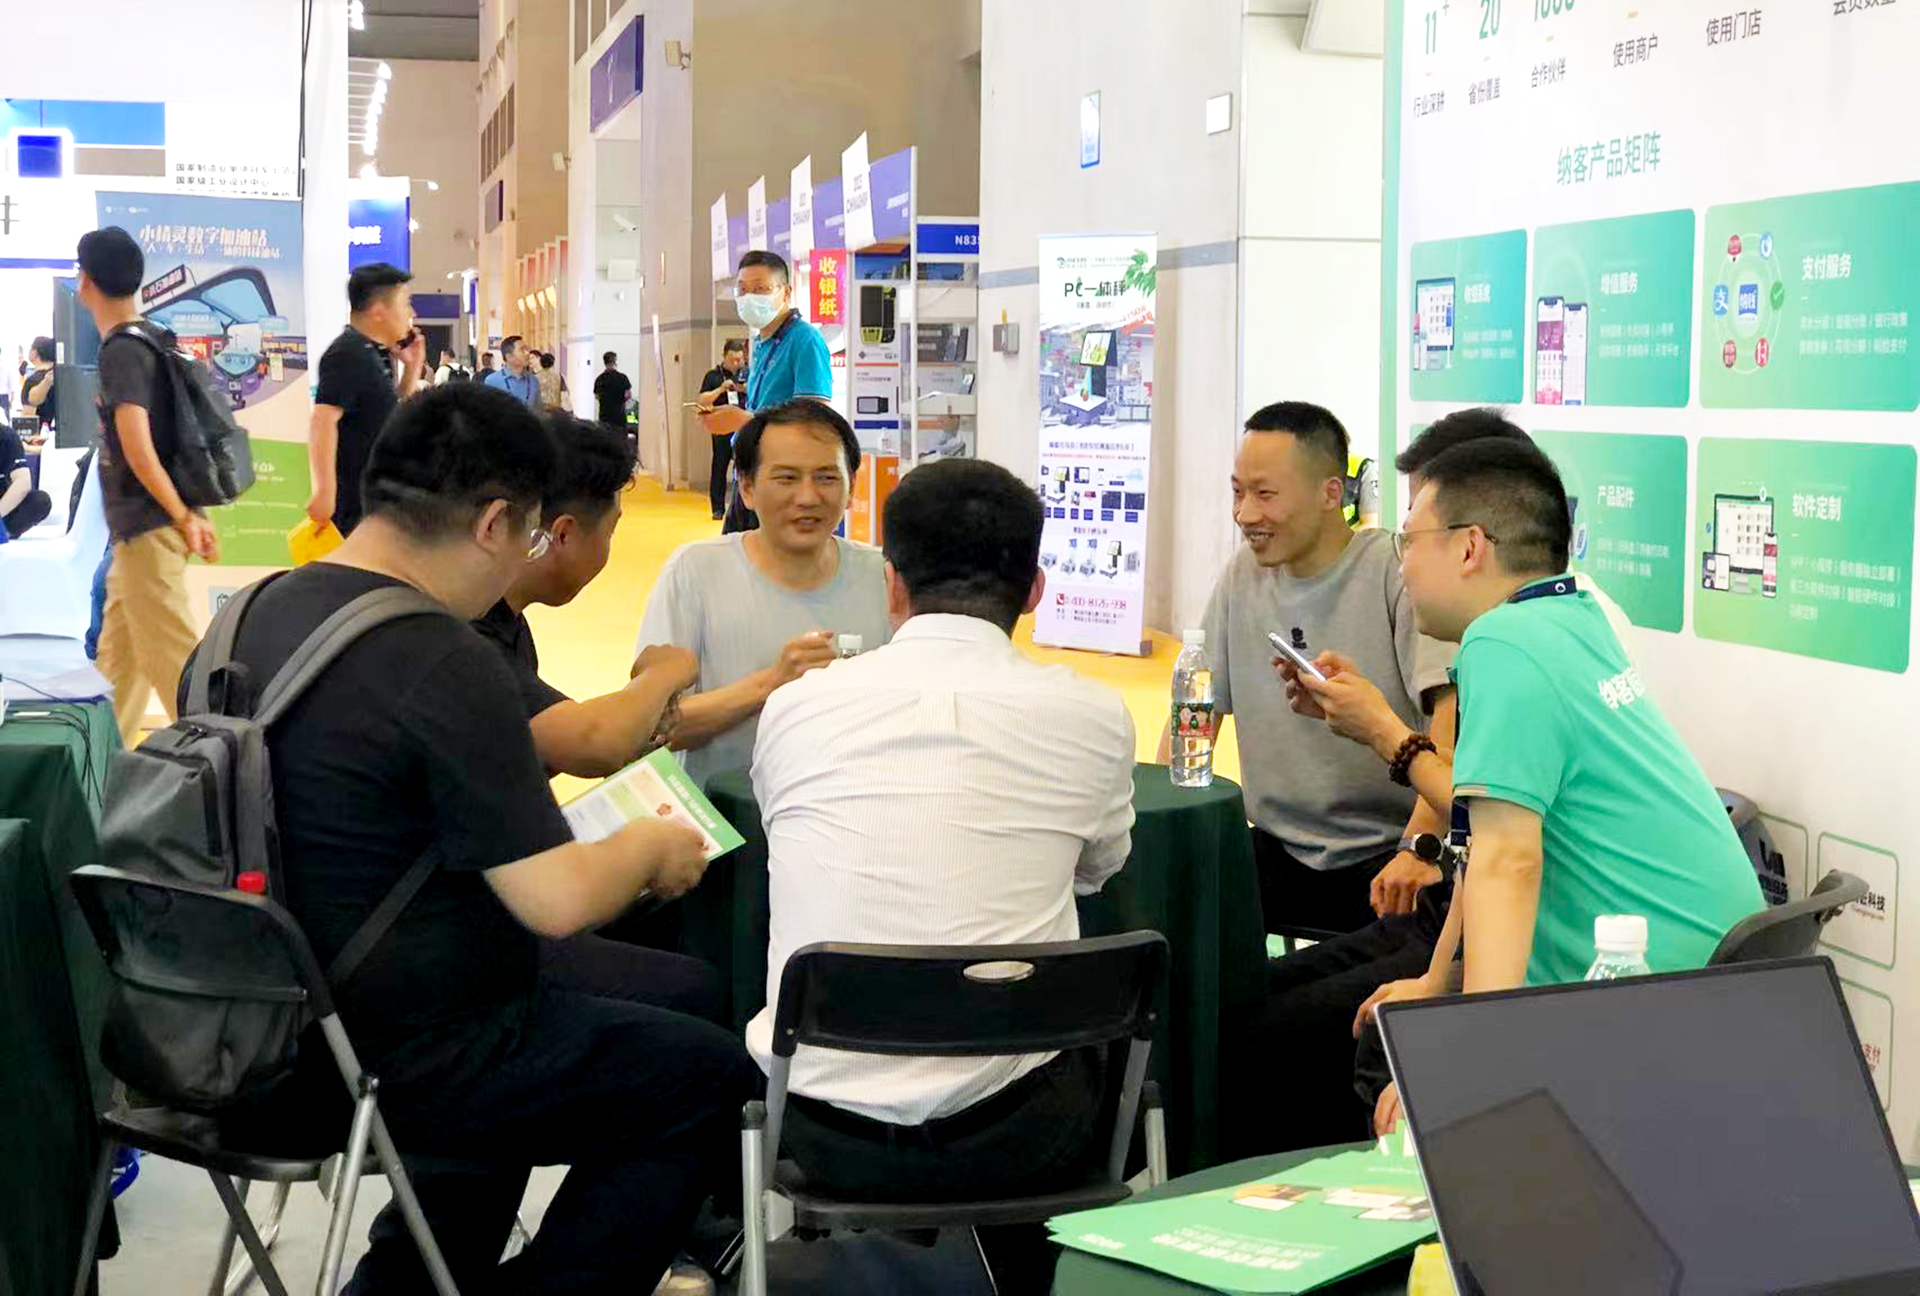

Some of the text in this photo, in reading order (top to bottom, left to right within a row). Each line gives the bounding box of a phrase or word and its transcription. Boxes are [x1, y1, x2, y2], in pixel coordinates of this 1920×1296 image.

[1706, 9, 1762, 47] 使用门店
[1613, 33, 1659, 68] 使用商户
[1530, 57, 1566, 89] 合作伙伴
[1468, 77, 1500, 106] 省份覆盖
[1556, 130, 1662, 186] 纳客产品矩阵
[139, 224, 268, 246] 小精灵数字加油站
[1801, 253, 1852, 280] 支付服务
[819, 256, 838, 317] 收银纸
[1600, 272, 1638, 295] 增值服务
[1597, 485, 1636, 509] 产品配件
[1792, 493, 1841, 522] 软件定制
